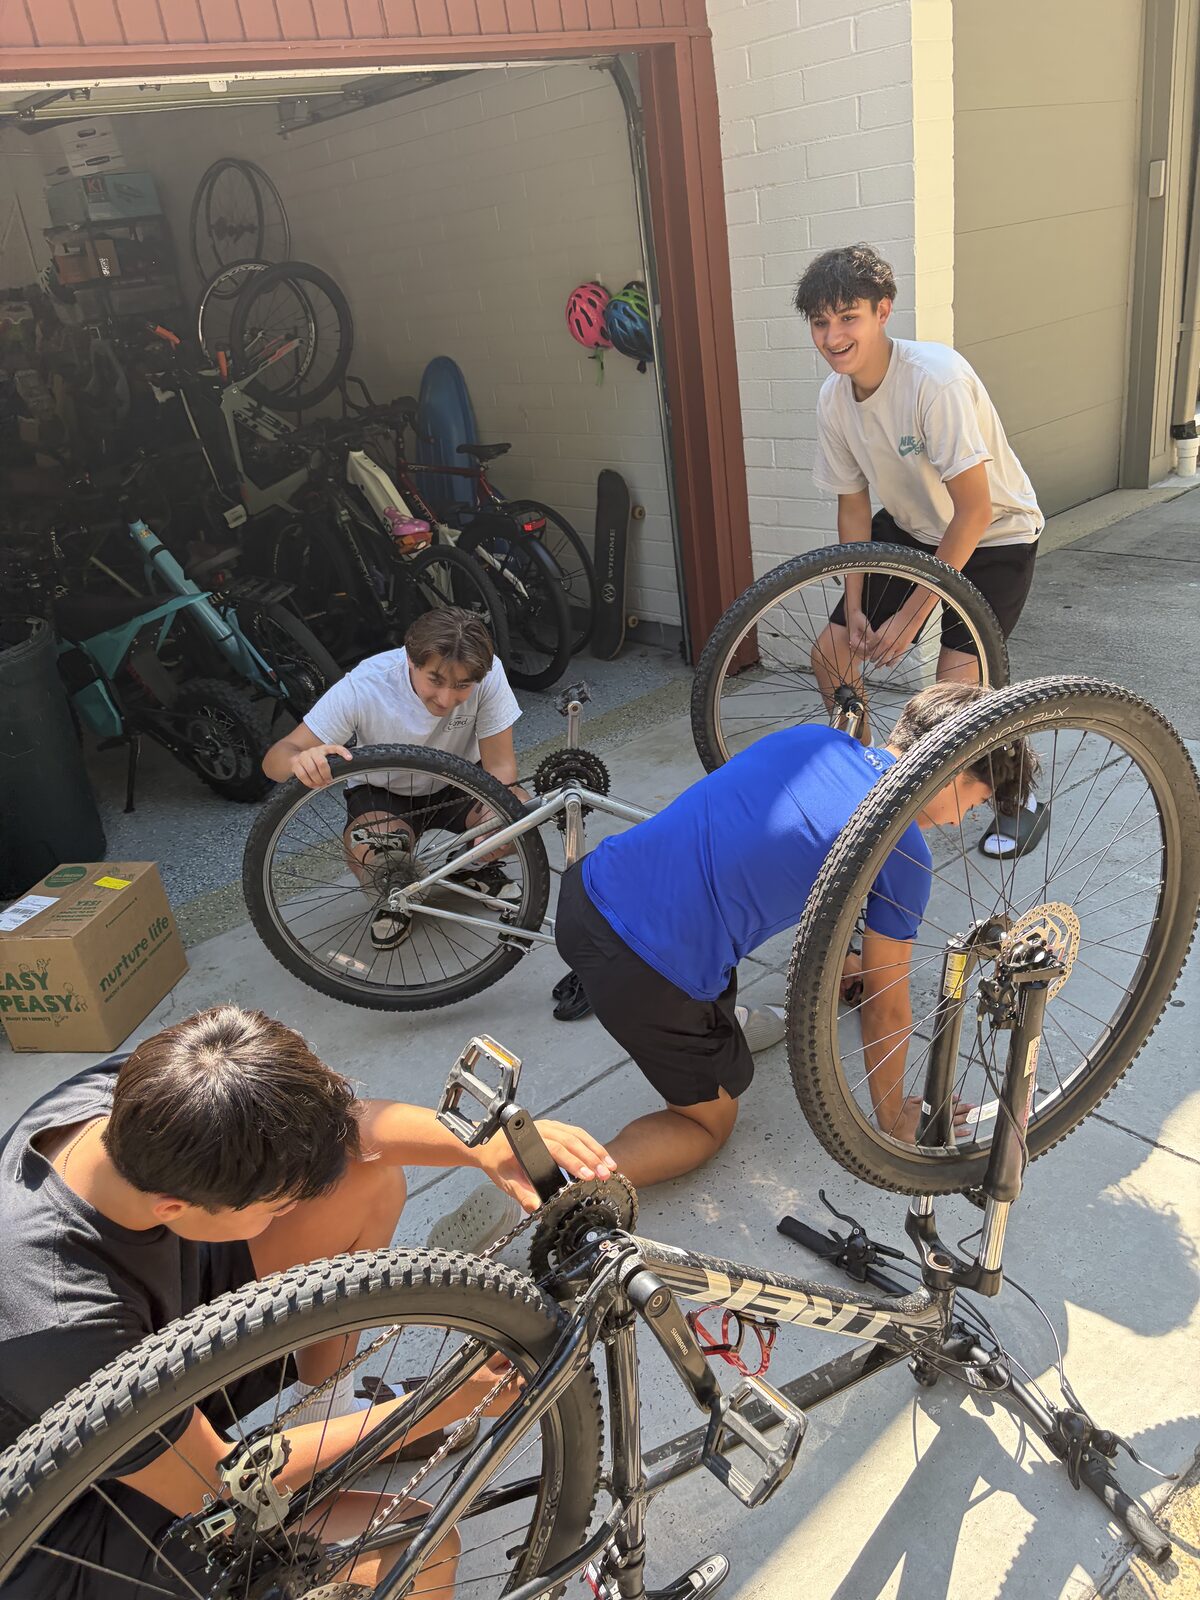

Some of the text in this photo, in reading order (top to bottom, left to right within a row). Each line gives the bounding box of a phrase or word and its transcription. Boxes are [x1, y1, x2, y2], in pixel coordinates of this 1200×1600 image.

[821, 561, 879, 573] BONTRAGER
[99, 937, 148, 992] nurture
[148, 915, 169, 942] life
[686, 1269, 891, 1343] TREK
[670, 1327, 688, 1356] SHIMANO
